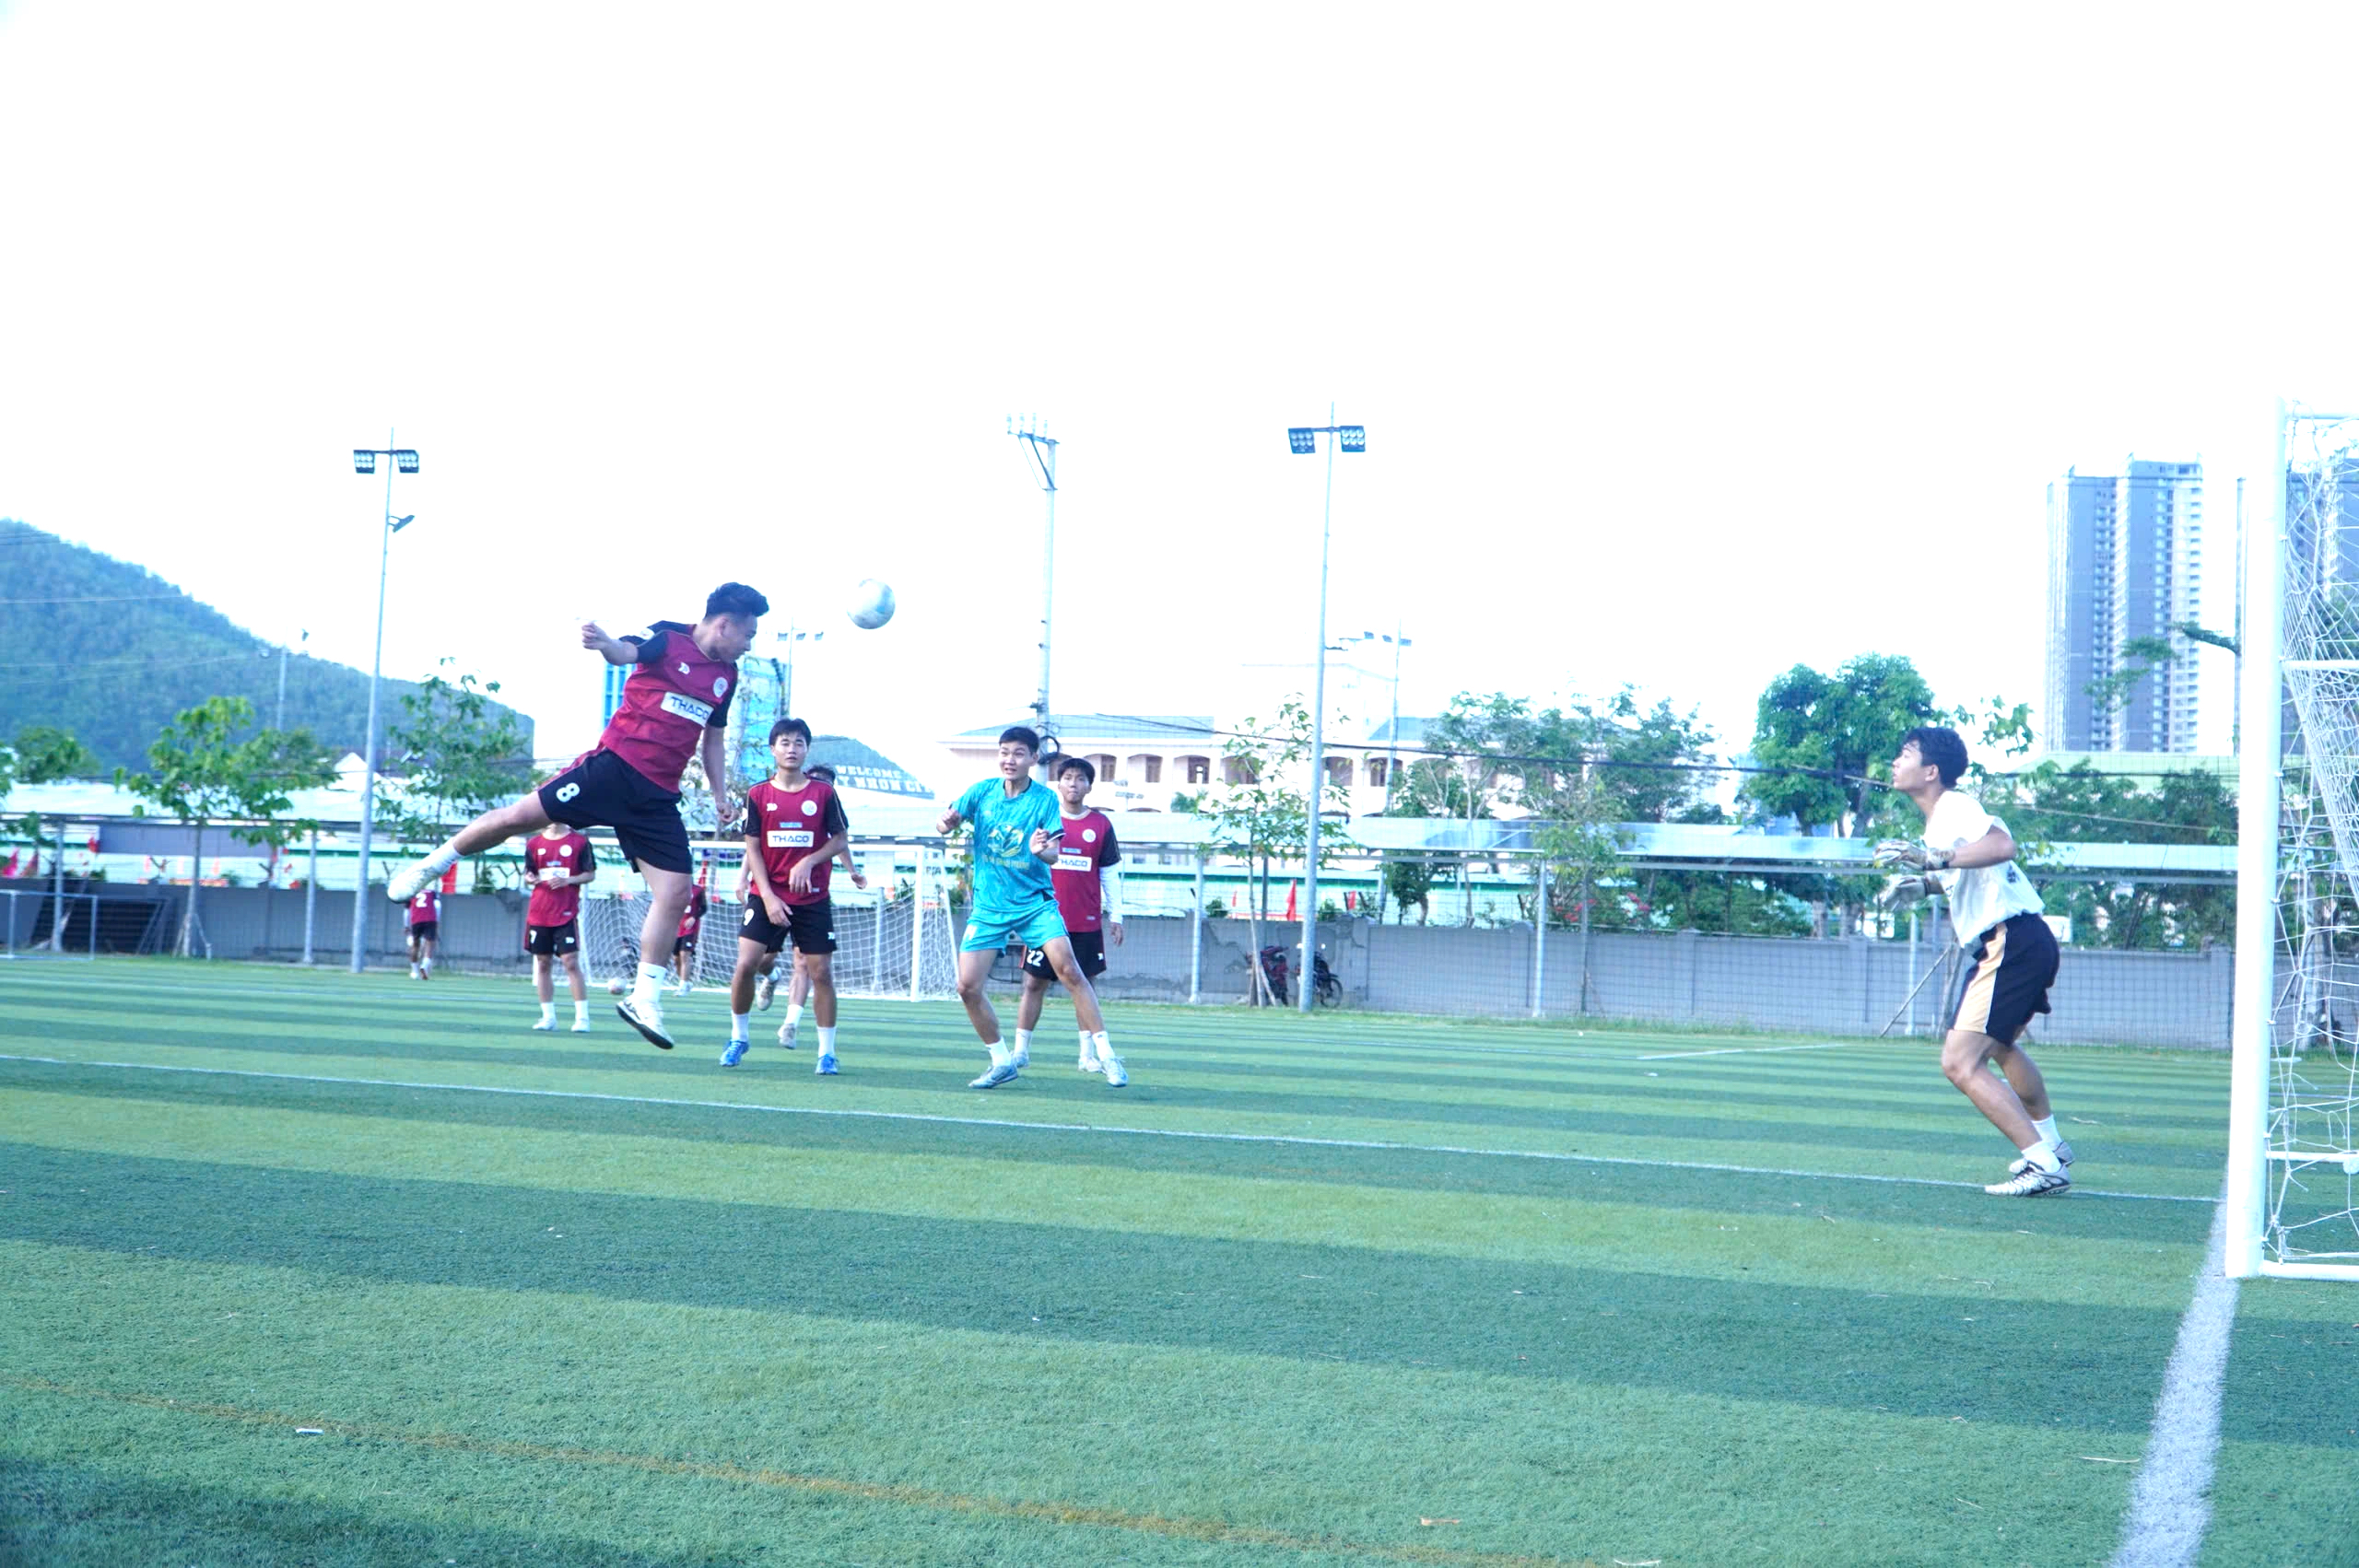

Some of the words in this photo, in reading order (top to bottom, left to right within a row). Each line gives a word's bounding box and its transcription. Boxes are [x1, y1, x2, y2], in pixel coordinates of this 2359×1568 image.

[671, 696, 710, 720] THACO
[835, 765, 902, 779] WELCOME
[854, 776, 902, 791] NHON
[556, 782, 581, 803] 8
[772, 835, 810, 843] THACO
[416, 892, 428, 908] 2
[743, 908, 755, 926] 9
[530, 930, 537, 944] 7
[1027, 950, 1045, 966] 22
